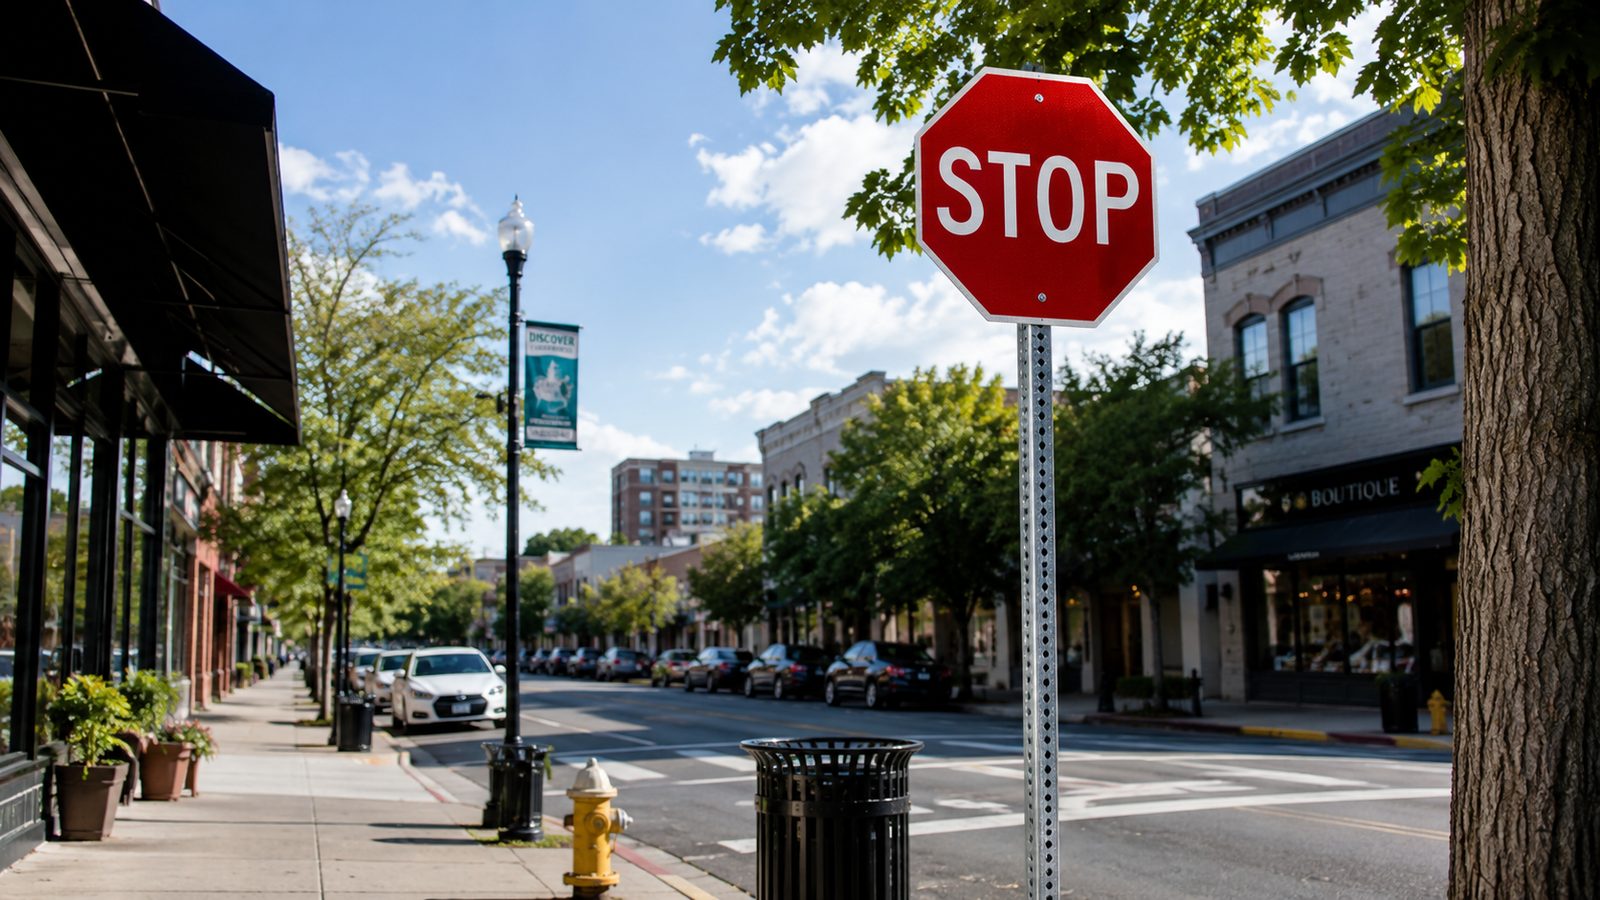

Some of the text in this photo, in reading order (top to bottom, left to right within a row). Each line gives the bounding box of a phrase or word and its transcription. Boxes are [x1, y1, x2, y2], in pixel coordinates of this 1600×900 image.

[937, 146, 1139, 245] STOP
[529, 332, 575, 346] DISCOVER
[1311, 477, 1400, 507] BOUTIQUE
